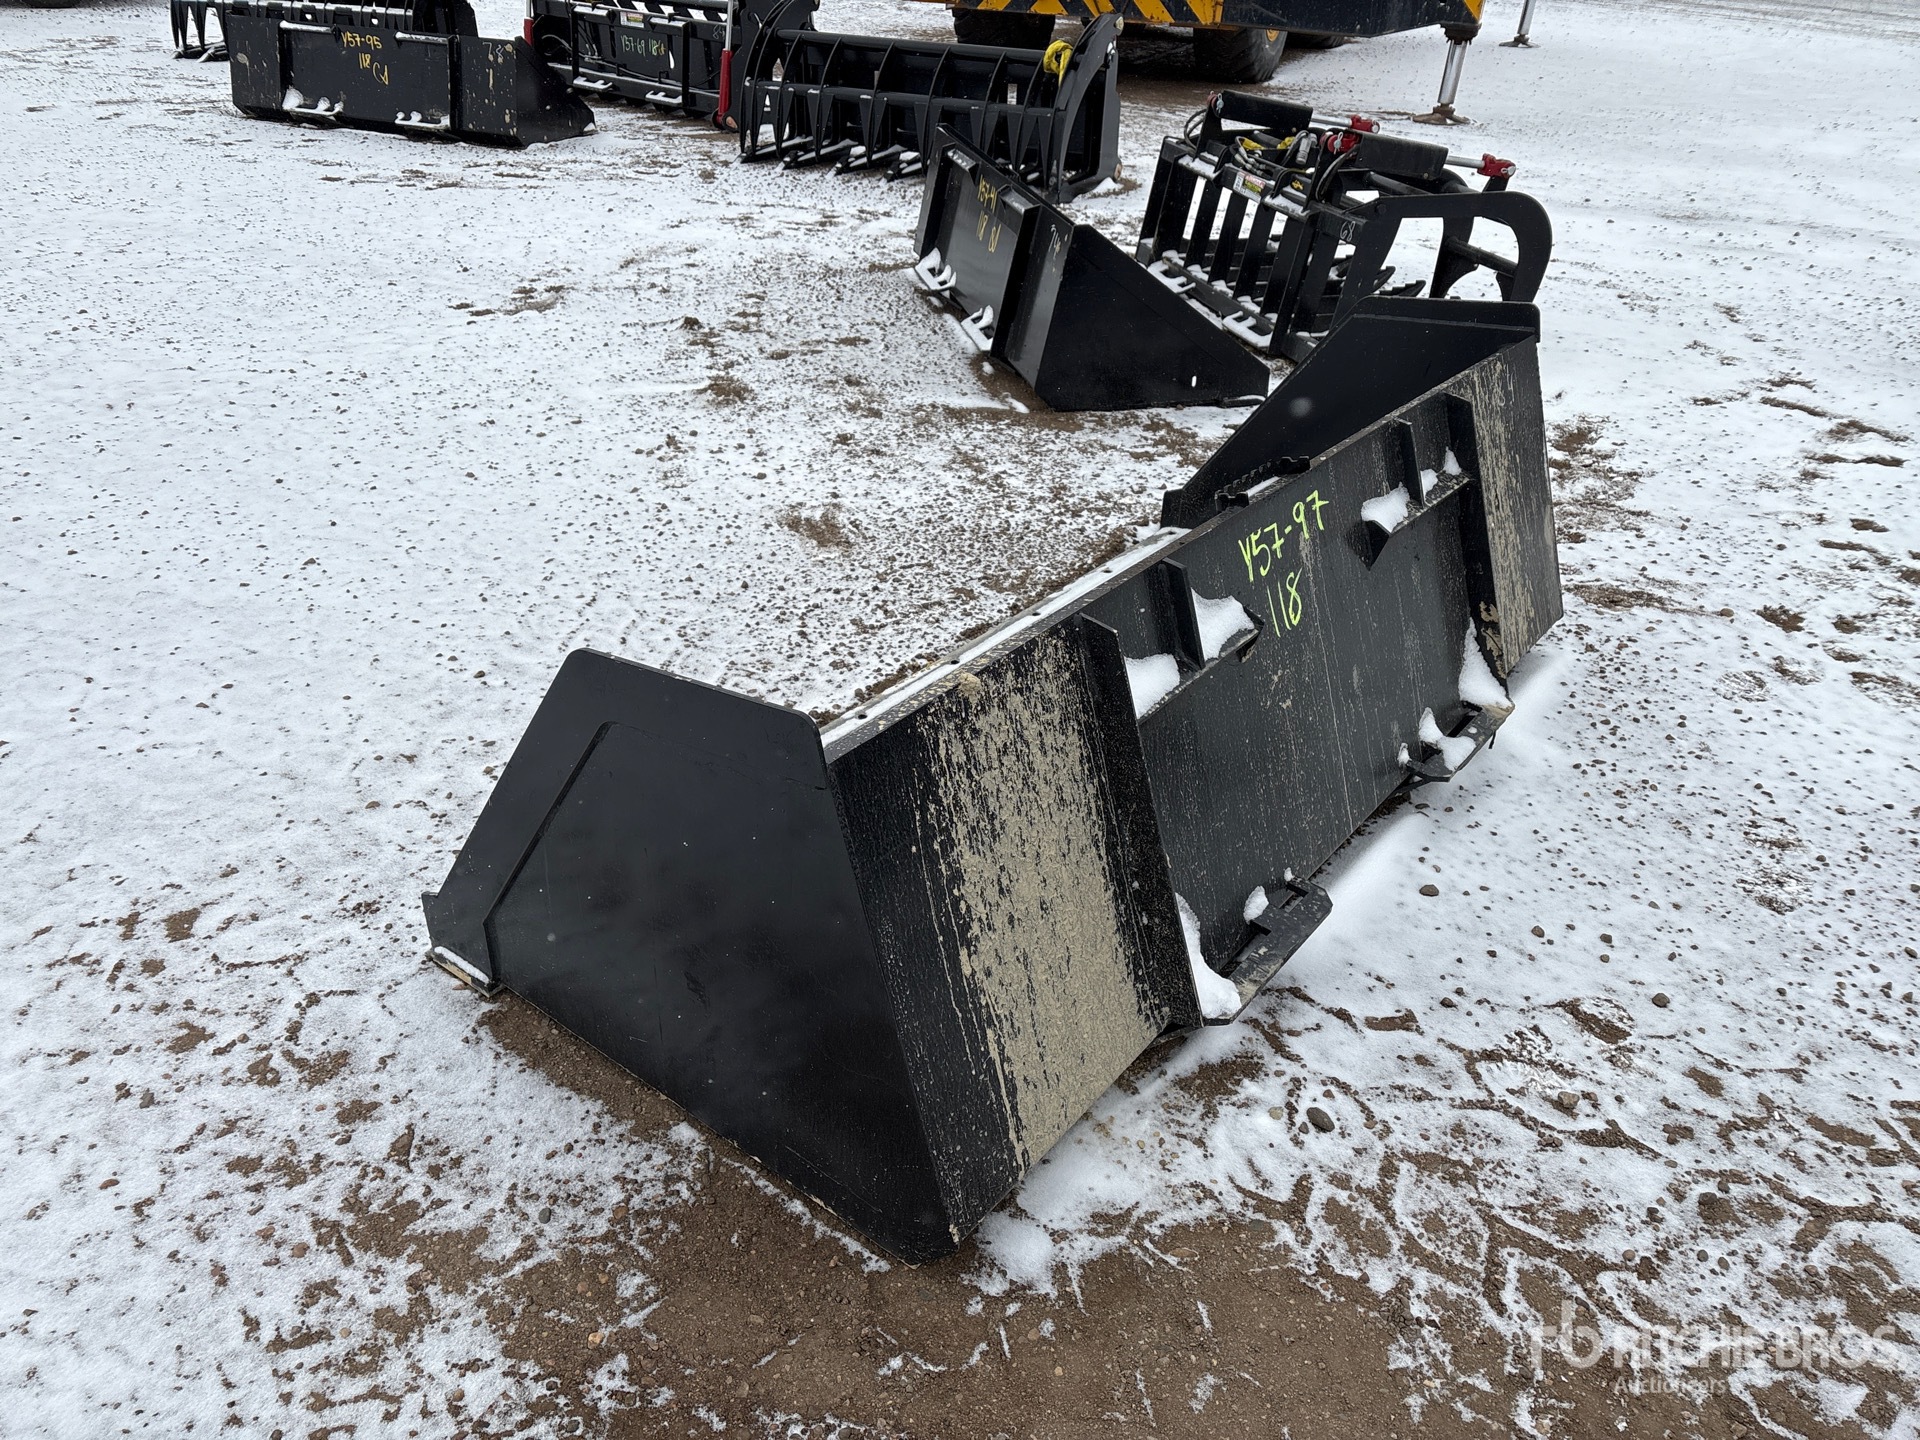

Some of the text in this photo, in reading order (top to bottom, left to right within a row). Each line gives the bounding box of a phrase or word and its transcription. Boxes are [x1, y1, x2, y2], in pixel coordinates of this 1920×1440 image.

[341, 30, 382, 50] Y57-95
[358, 52, 371, 69] 118
[1238, 489, 1330, 583] Y57-97
[1266, 567, 1303, 638] 118
